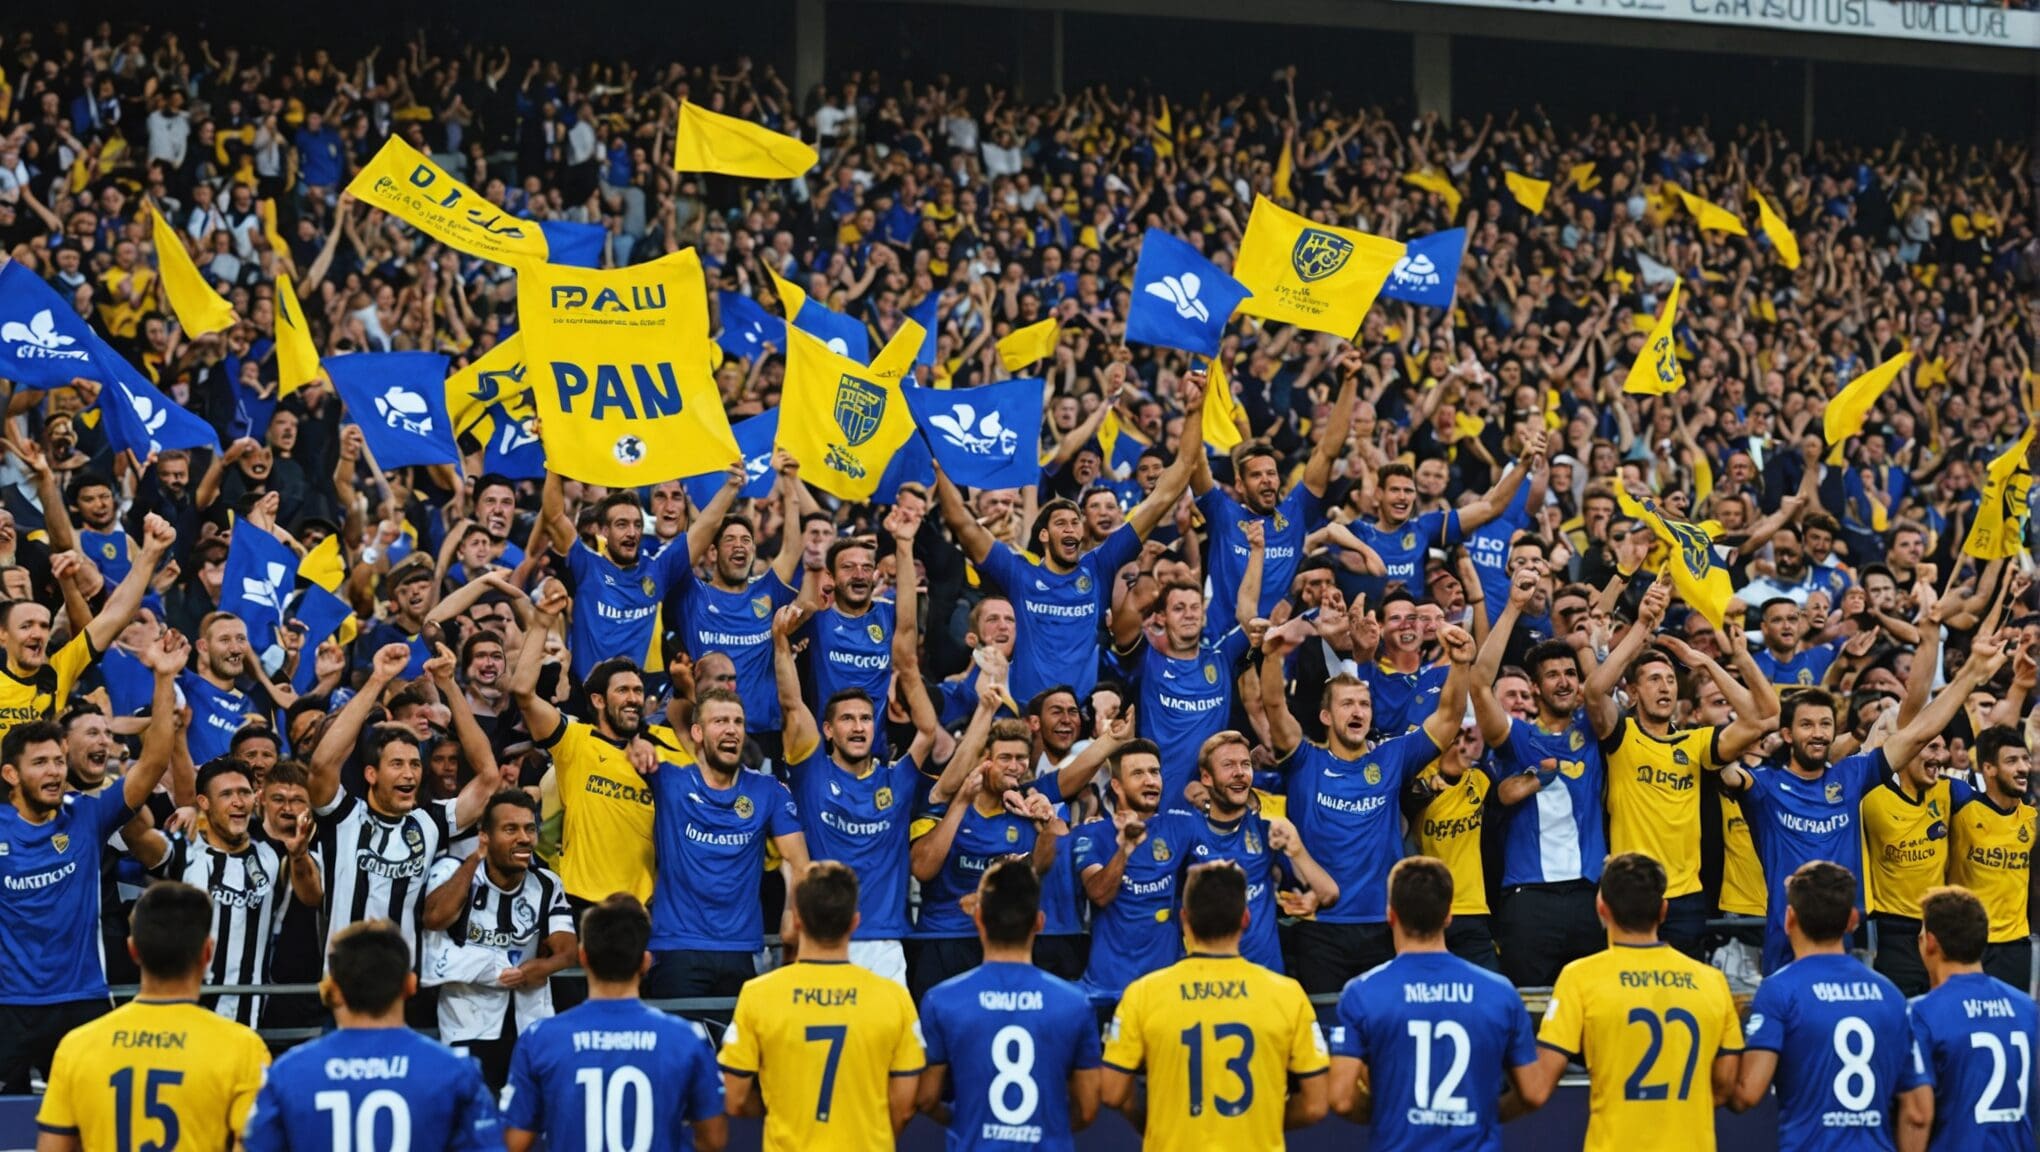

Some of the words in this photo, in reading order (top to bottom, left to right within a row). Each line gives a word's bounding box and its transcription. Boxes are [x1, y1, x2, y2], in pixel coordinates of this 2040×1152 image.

[550, 362, 683, 421] PAN
[805, 1025, 847, 1123] 7
[988, 1024, 1039, 1125] 8
[1181, 1021, 1255, 1118] 13
[1407, 1019, 1471, 1110] 12
[1624, 1007, 1701, 1101] 27
[1833, 1016, 1876, 1111] 8
[109, 1066, 184, 1152] 15
[314, 1089, 412, 1152] 10
[575, 1065, 654, 1152] 10
